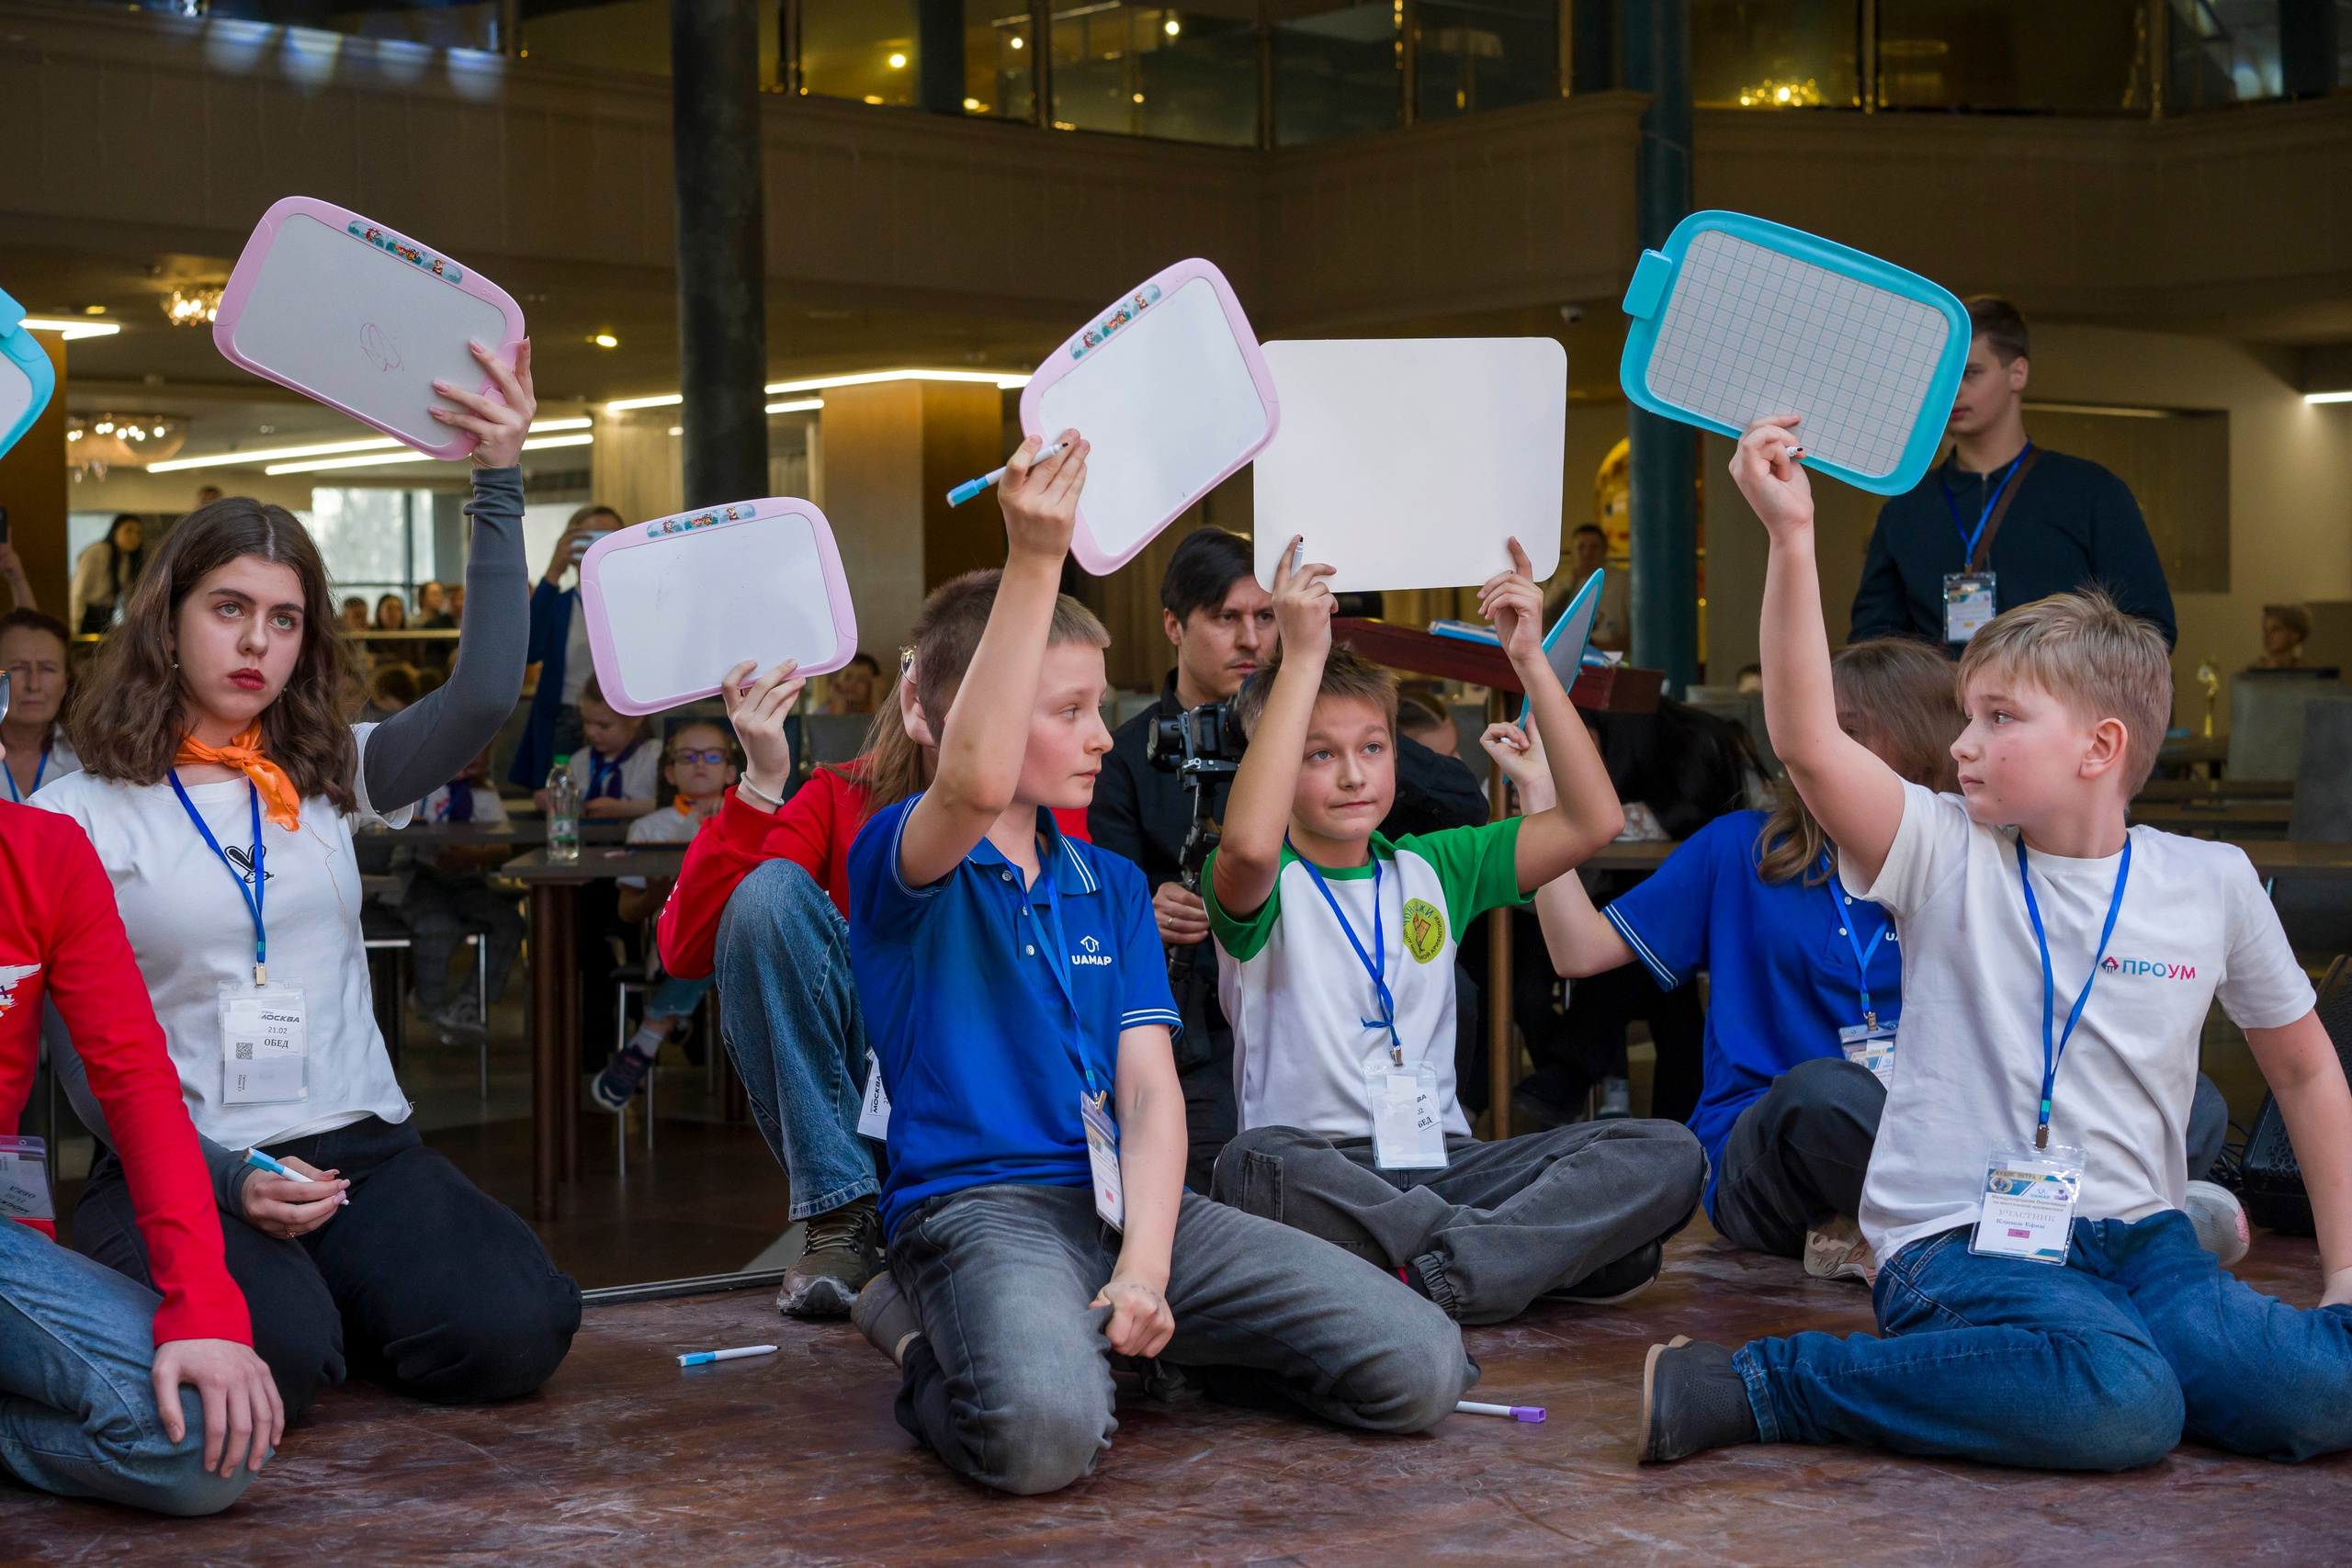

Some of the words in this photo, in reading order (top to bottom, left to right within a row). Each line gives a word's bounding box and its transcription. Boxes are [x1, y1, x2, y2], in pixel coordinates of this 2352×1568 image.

[1071, 954, 1113, 965] UAMAP
[2122, 959, 2196, 980] ПРОУМ
[267, 1026, 288, 1034] 21.02
[264, 1038, 289, 1049] ОБЕД
[873, 1076, 881, 1113] МОСКВА
[1418, 1116, 1432, 1128] БЕД
[1997, 1209, 2056, 1223] УЧАСТНИК
[1996, 1218, 2023, 1226] Климов
[2024, 1222, 2045, 1230] Ефим
